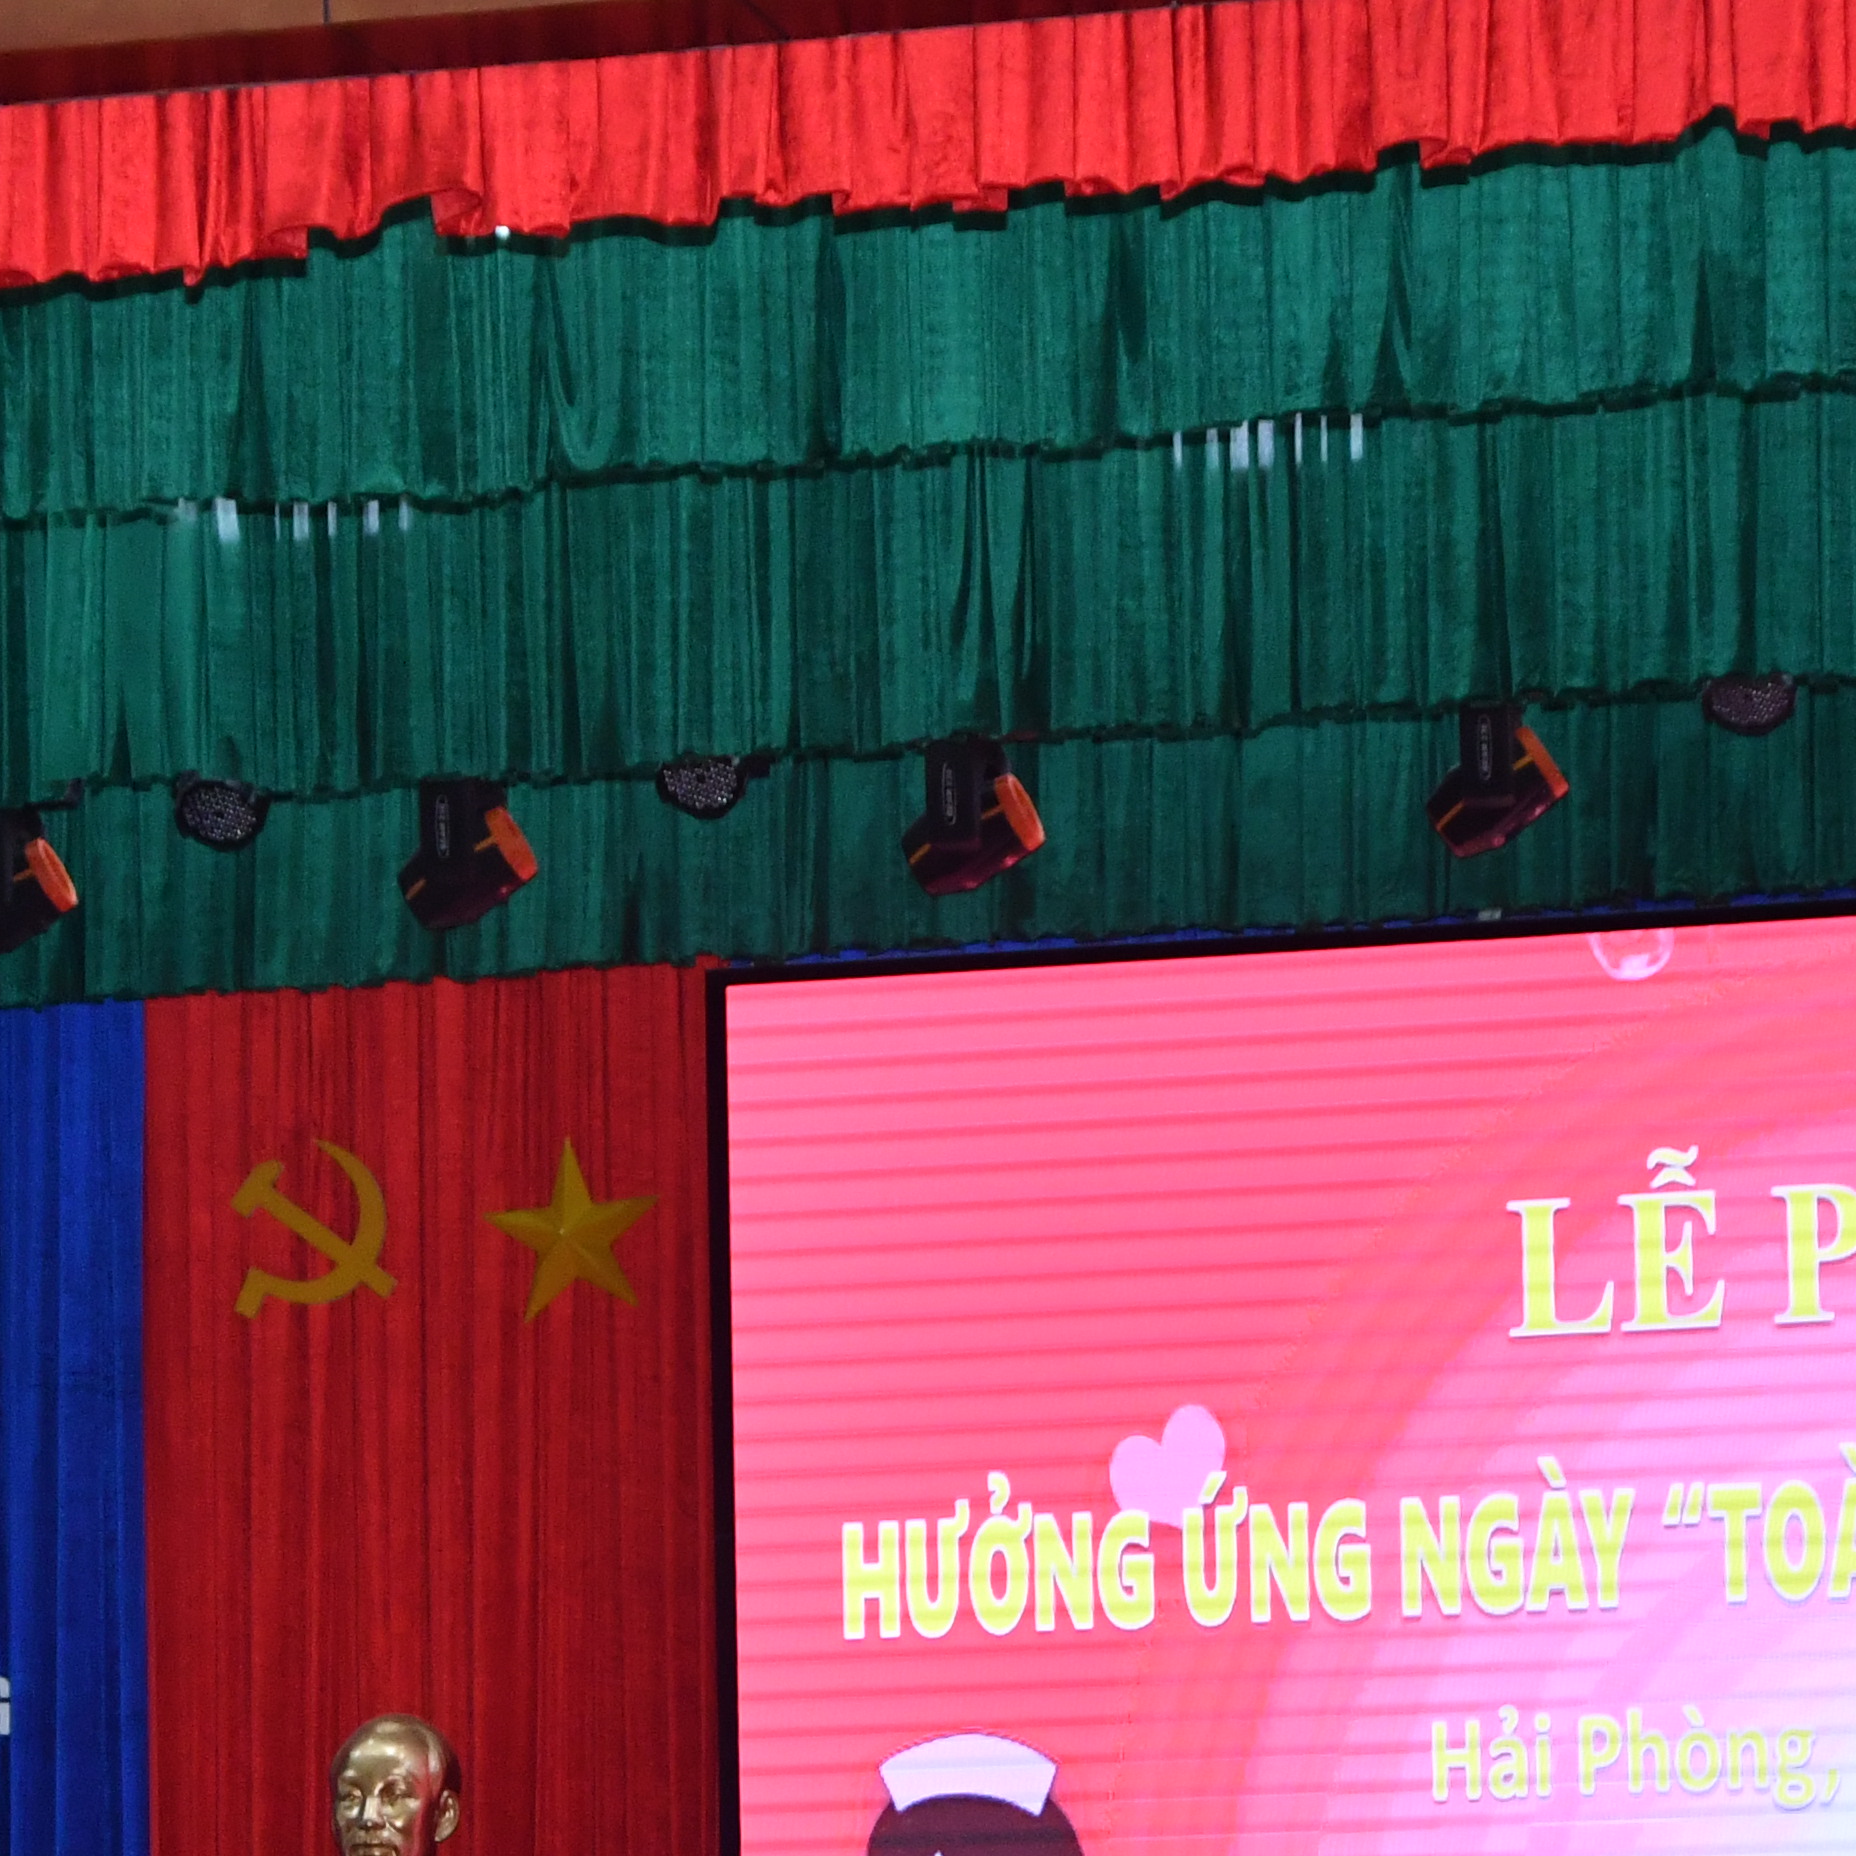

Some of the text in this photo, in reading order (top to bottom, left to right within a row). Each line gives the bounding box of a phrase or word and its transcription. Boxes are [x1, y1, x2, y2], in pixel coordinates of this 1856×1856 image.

[1506, 1145, 1725, 1339] LỄ
[841, 1471, 1155, 1641] HƯỞNG
[1182, 1470, 1372, 1627] ỨNG
[1400, 1456, 1635, 1618] NGÀY
[1431, 1706, 1550, 1802] Hải
[1578, 1703, 1842, 1811] Phòng,
